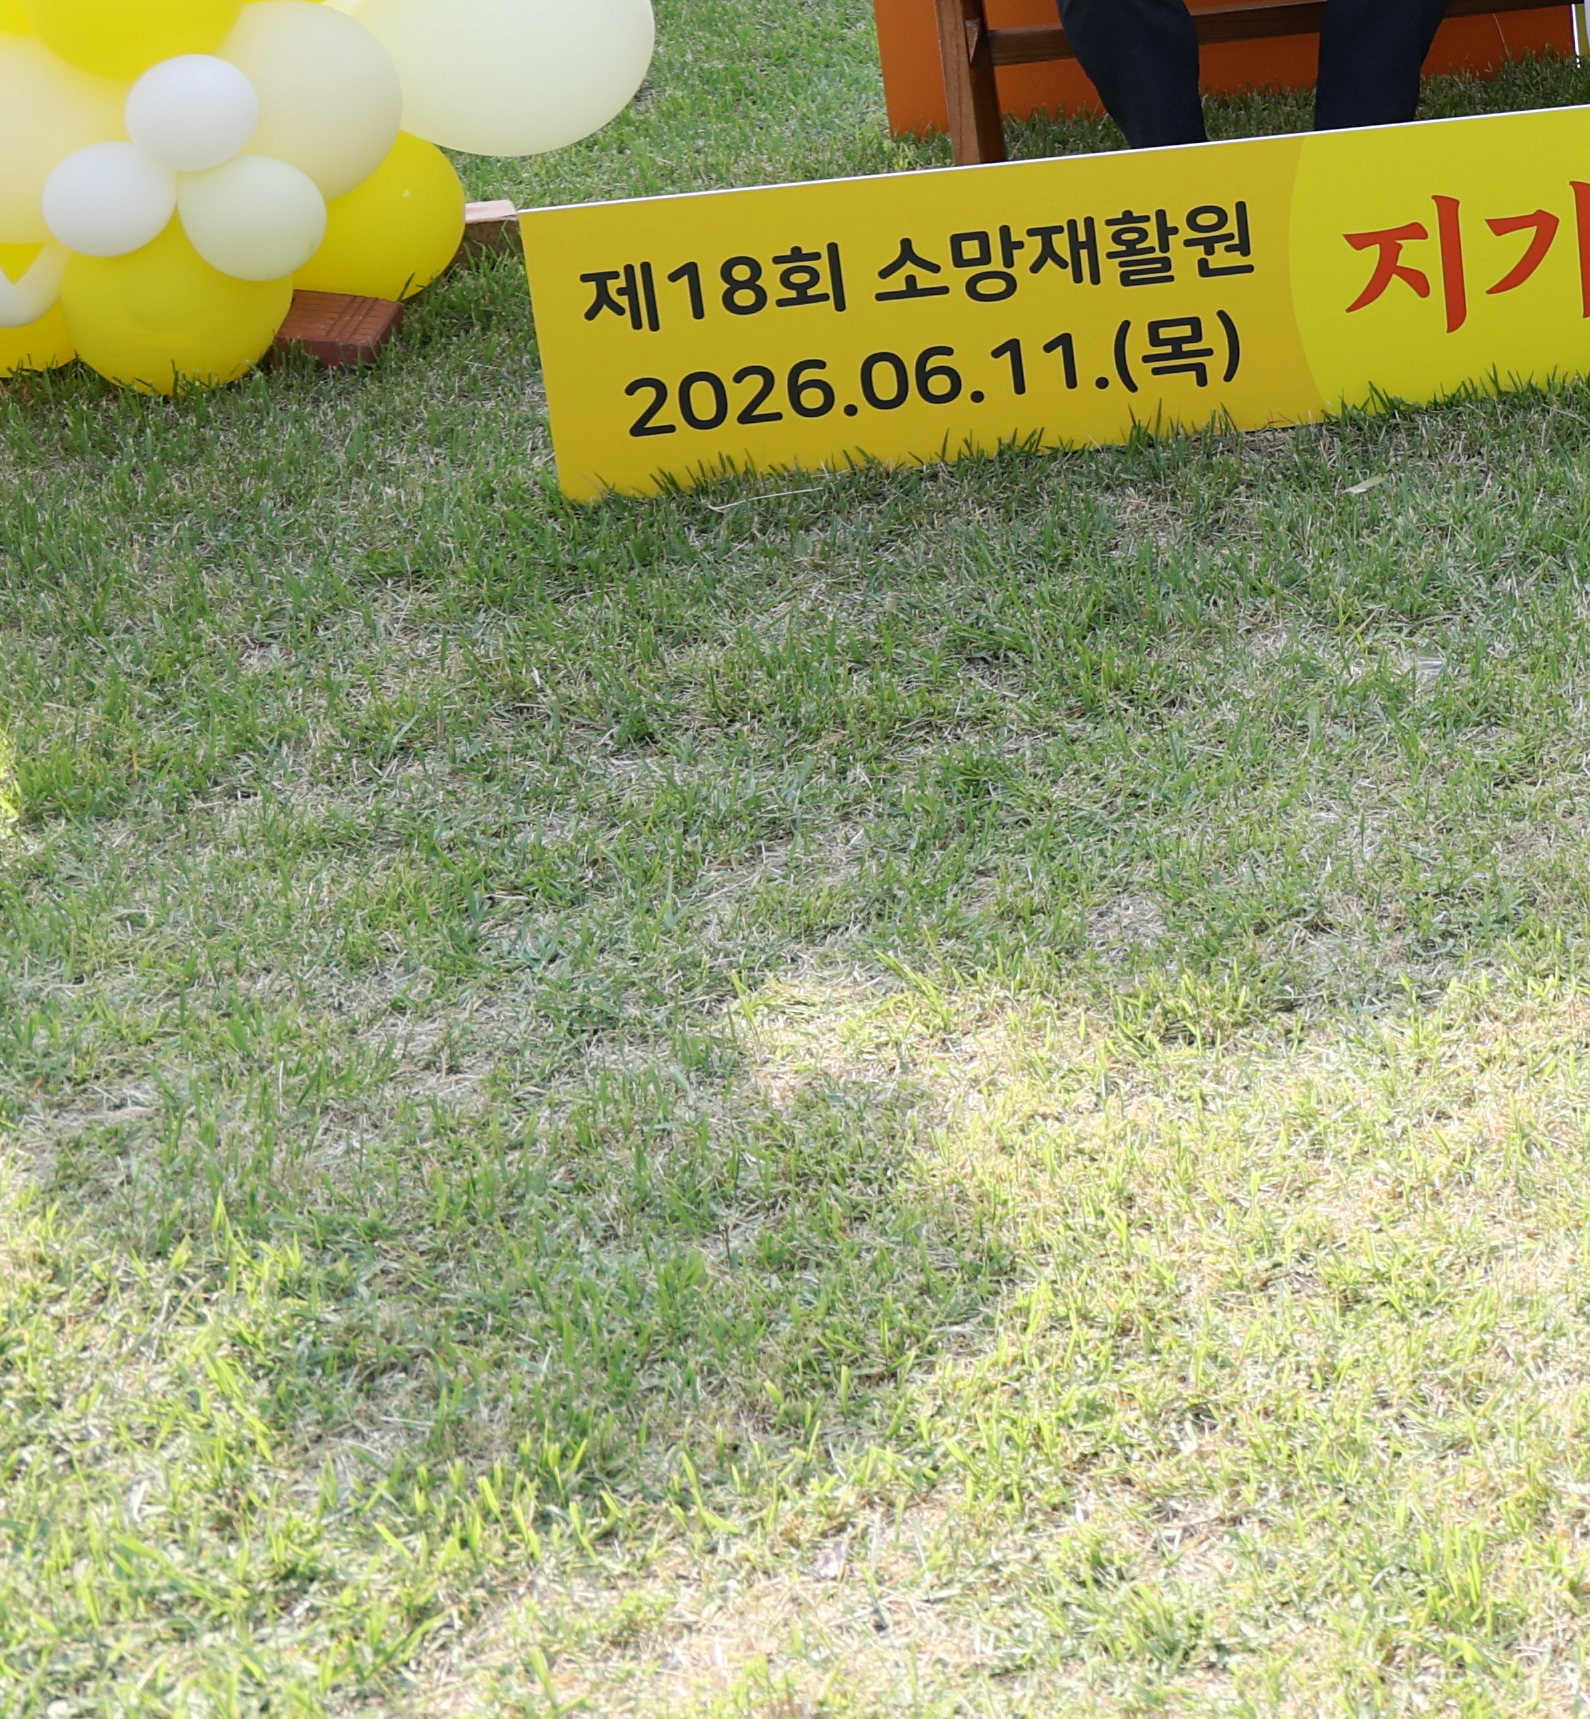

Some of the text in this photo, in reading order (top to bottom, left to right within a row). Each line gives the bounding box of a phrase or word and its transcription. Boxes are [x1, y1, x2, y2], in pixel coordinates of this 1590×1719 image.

[579, 200, 1255, 332] 제18회 소망재활원
[624, 310, 1241, 438] 2026.06.11.(목)
